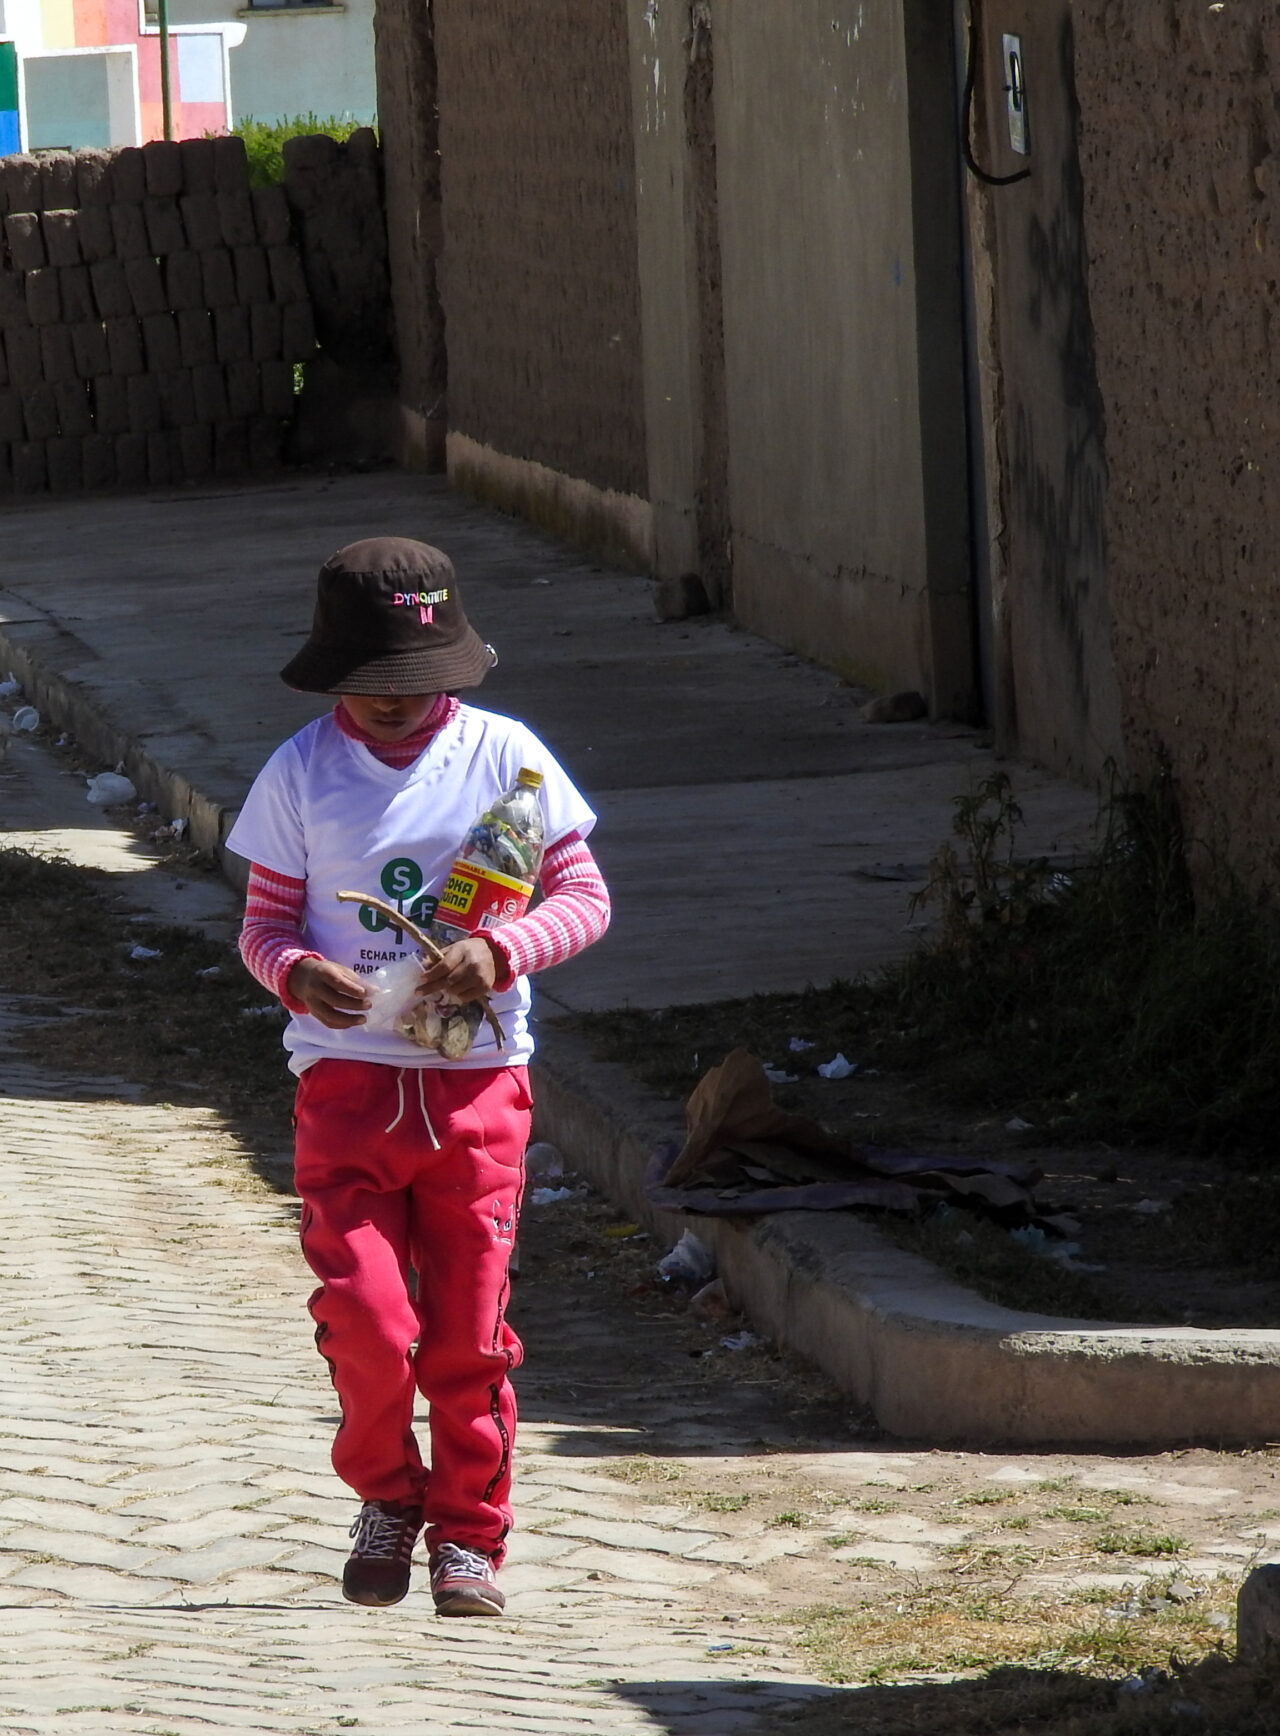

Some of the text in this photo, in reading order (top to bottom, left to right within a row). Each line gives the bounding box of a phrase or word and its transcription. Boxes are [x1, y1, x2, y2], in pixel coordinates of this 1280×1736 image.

[392, 866, 411, 892] S
[448, 878, 473, 896] OKA
[368, 907, 379, 926] T
[421, 902, 434, 920] F
[360, 949, 396, 961] ECHAR
